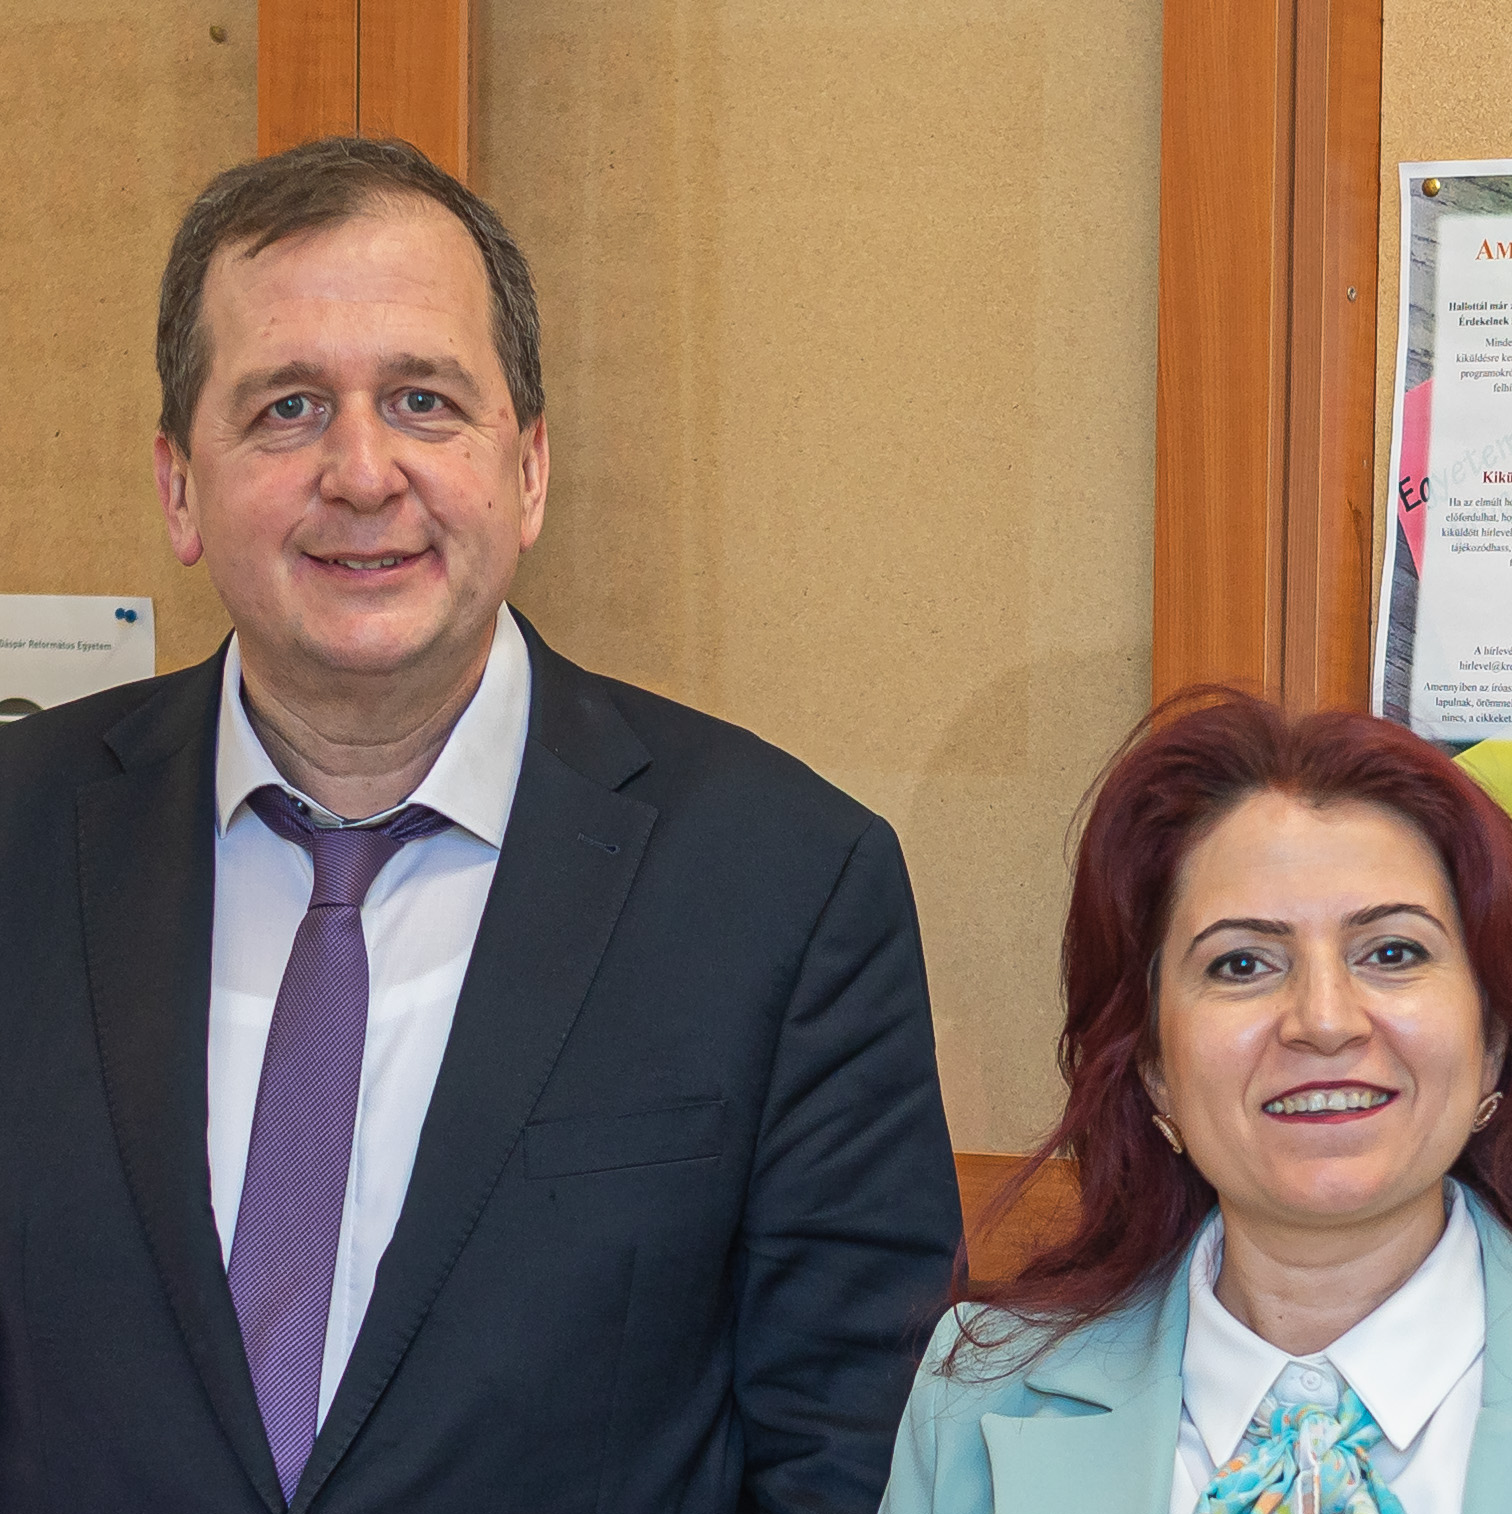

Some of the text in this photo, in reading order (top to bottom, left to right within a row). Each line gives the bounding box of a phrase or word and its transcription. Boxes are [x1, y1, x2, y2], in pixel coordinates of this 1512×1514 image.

[1448, 301, 1487, 311] Hallottál
[1489, 300, 1508, 310] már
[1458, 315, 1509, 326] Érdekelnek
[28, 639, 75, 650] Református
[76, 640, 112, 652] Egyetem
